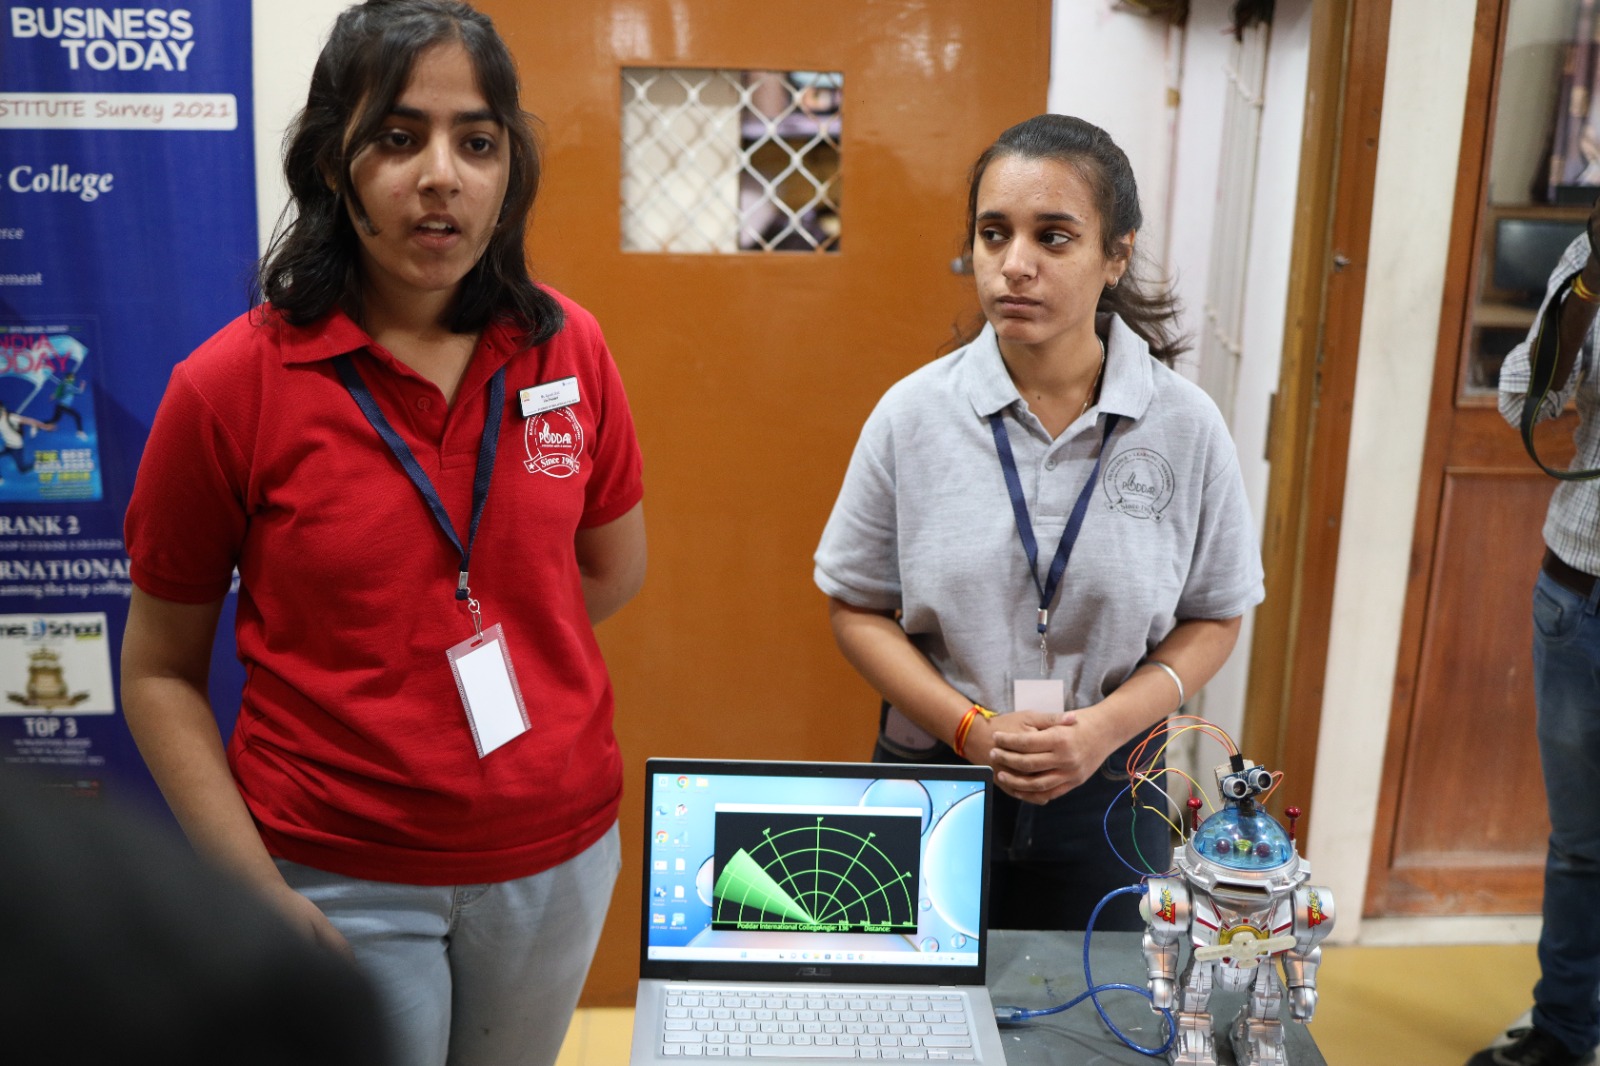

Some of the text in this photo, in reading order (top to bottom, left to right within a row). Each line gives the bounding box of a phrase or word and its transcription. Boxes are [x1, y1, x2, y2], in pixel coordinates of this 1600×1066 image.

[10, 7, 194, 40] BUSINESS
[60, 39, 195, 71] TODAY
[0, 100, 231, 124] STITUTE Survey 2021
[8, 163, 114, 202] College
[540, 457, 560, 468] Since
[0, 515, 81, 536] RANK 2
[24, 717, 78, 738] TOP 3
[760, 922, 798, 931] International
